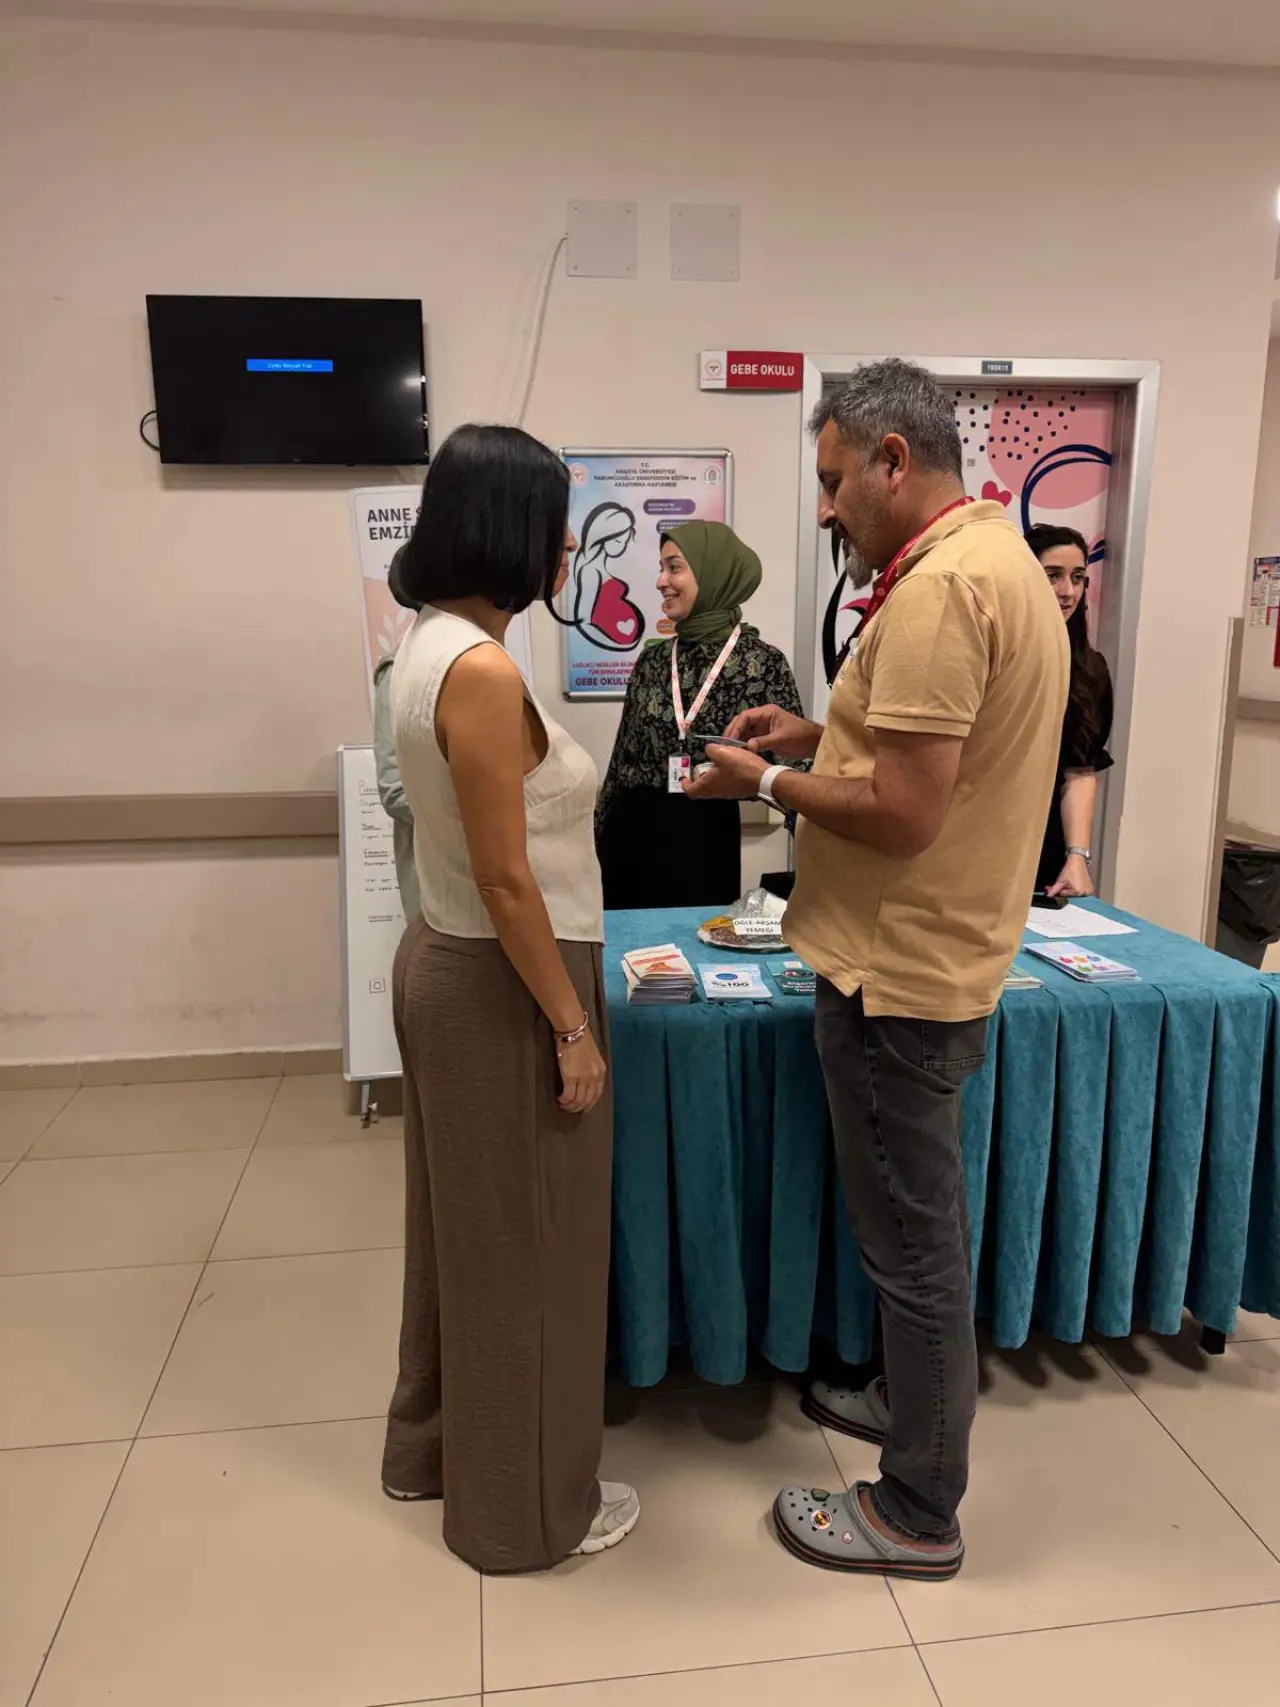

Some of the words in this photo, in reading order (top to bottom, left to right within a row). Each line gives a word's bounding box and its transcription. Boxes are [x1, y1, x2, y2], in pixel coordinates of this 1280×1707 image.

[730, 364, 758, 375] GEBE
[760, 364, 795, 376] OKULU
[367, 508, 412, 523] ANNE
[575, 677, 599, 686] GEBE
